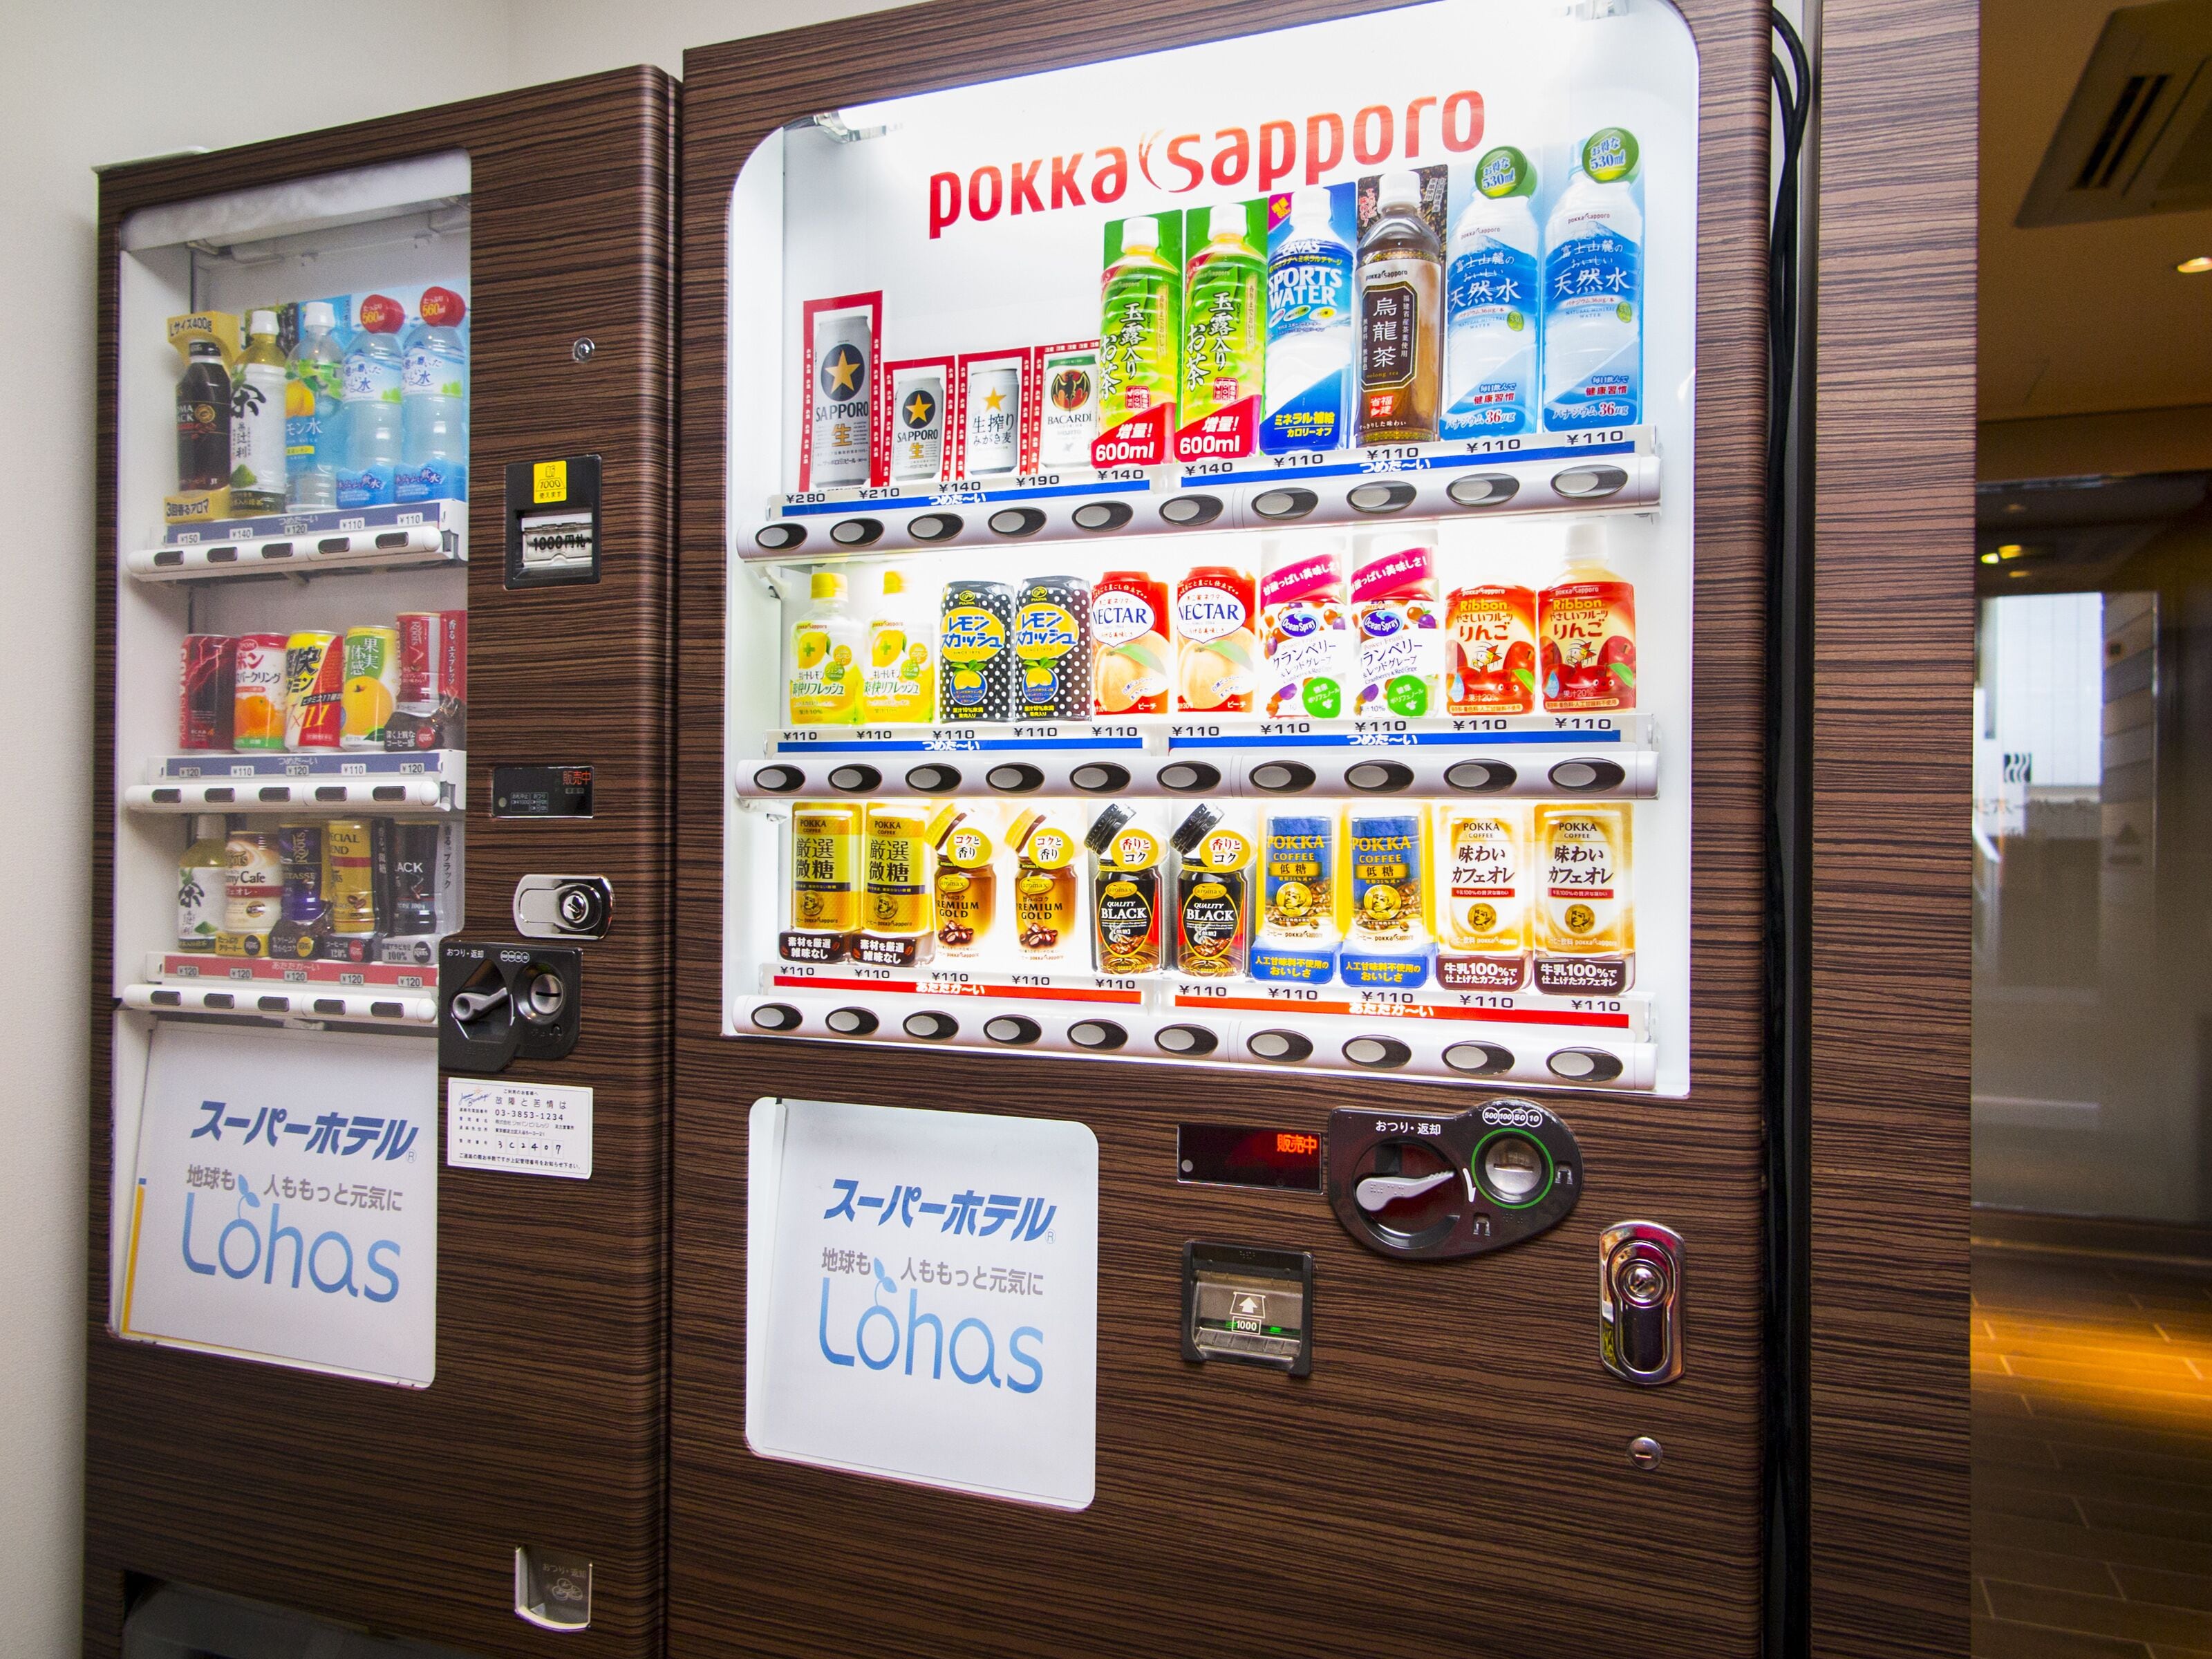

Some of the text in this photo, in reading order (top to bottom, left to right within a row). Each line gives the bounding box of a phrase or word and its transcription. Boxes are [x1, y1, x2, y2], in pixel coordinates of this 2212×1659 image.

[1268, 265, 1342, 295] SPORTS
[1553, 267, 1631, 299] 天然水
[1270, 285, 1338, 311] WATER
[1450, 278, 1521, 313] 天然水
[1209, 292, 1236, 371] 玉露入り
[1373, 297, 1398, 368] 烏龍茶
[1120, 303, 1145, 379] 玉露入り
[1186, 324, 1210, 391] お茶
[1100, 335, 1122, 400] お茶
[1586, 386, 1627, 396] 健康習慣
[1474, 393, 1515, 404] 健康習慣
[816, 402, 868, 422] SAPPORO
[972, 413, 1014, 434] 生搾り
[1202, 416, 1238, 432] 増量!
[1275, 413, 1335, 427] ミネラル補給
[832, 423, 852, 447] 生
[897, 429, 938, 442] SAPPORO
[1116, 422, 1152, 439] 増量!
[1287, 427, 1332, 438] カロリーオフ
[1567, 430, 1624, 444] ¥110
[973, 433, 1011, 445] みがき麦
[1179, 435, 1240, 456] 600ml
[1466, 438, 1521, 453] ¥110
[909, 442, 924, 459] 生
[1096, 441, 1154, 462] 600ml
[1367, 447, 1418, 460] ¥110
[1274, 454, 1324, 467] ¥110
[1098, 469, 1144, 480] ¥140
[1185, 462, 1233, 475] ¥140
[541, 480, 561, 489] 1000
[939, 482, 982, 492] ¥140
[1016, 475, 1060, 486] ¥190
[787, 492, 825, 503] ¥280
[859, 487, 900, 500] ¥210
[1460, 599, 1508, 612] Ribbon
[1553, 599, 1602, 610] Ribbon
[1179, 603, 1239, 621] NECTAR
[1456, 612, 1513, 622] やさしいフルーツ
[1550, 610, 1608, 621] やさしいフルーツ
[949, 616, 989, 632] レモン
[1022, 612, 1062, 629] レモン
[1282, 618, 1315, 632] Ocean Spray
[1365, 617, 1398, 631] Ocean Spray
[1460, 621, 1510, 641] りんご
[1554, 619, 1605, 639] りんご
[941, 632, 1004, 648] スカッシュ
[1017, 629, 1078, 646] スカッシュ
[351, 645, 366, 675] 体感
[364, 638, 379, 669] 果実
[1273, 640, 1336, 670] クランベリー
[1261, 723, 1310, 733] ¥110
[1355, 721, 1407, 731] ¥110
[1453, 720, 1507, 730] ¥110
[1555, 718, 1611, 729] ¥110
[783, 731, 817, 740] ¥110
[856, 730, 892, 739] ¥110
[932, 729, 975, 739] ¥110
[1013, 727, 1057, 737] ¥110
[1092, 727, 1137, 736] ¥110
[1172, 726, 1220, 736] ¥110
[563, 771, 591, 785] 販売中
[1463, 823, 1499, 831] POKKA
[1559, 823, 1597, 832] POKKA
[955, 836, 980, 845] コクと
[1037, 837, 1062, 846] コクと
[1123, 839, 1150, 850] 香りと
[1212, 838, 1241, 851] 香りと
[1266, 835, 1324, 850] POKKA
[1352, 836, 1412, 852] POKKA
[796, 838, 834, 859] 厳選
[870, 840, 909, 861] 厳選
[958, 847, 975, 859] 香り
[1040, 849, 1058, 860] 香り
[1458, 845, 1506, 863] 味わい
[1555, 845, 1604, 863] 味わい
[1125, 853, 1147, 863] コク
[1215, 853, 1236, 863] コク
[1359, 854, 1402, 863] COFFEE
[796, 859, 834, 879] 微糖
[870, 861, 909, 882] 微糖
[1280, 864, 1306, 874] 低糖
[1367, 865, 1394, 877] 低糖
[241, 871, 265, 883] Cafe
[1452, 867, 1515, 885] カフェオレ
[1548, 867, 1614, 885] カフェオレ
[935, 899, 979, 909] PREMIUM
[939, 909, 968, 918] GOLD
[1101, 908, 1147, 919] BLACK
[1187, 909, 1234, 921] BLACK
[780, 967, 814, 976] ¥110
[855, 969, 890, 980] ¥110
[1270, 967, 1311, 977] おいしさ
[1444, 963, 1517, 976] 牛乳100%で
[1541, 964, 1617, 978] 牛乳100%で
[932, 972, 968, 982] ¥110
[1012, 975, 1050, 986] ¥110
[1361, 971, 1403, 982] おいしさ
[1445, 974, 1517, 986] 仕上げたカフェオレ
[1541, 975, 1617, 987] 仕上げたカフェオレ
[495, 1109, 563, 1121] 03-3853-1234
[1483, 1112, 1499, 1121] 500
[1513, 1113, 1526, 1121] 50
[1528, 1114, 1540, 1123] 10
[190, 1100, 419, 1161] スーパーホテル
[1375, 1120, 1441, 1136] おつり・返却
[1277, 1133, 1318, 1155] 販売中
[187, 1164, 403, 1211] 地球も 人ももっと元気に
[823, 1179, 1057, 1241] スーパーホテル
[182, 1192, 400, 1303] Lohas
[822, 1246, 1043, 1295] 地球も 人ももっと元気に
[1236, 1321, 1257, 1331] 1000
[819, 1277, 1043, 1394] Lohas
